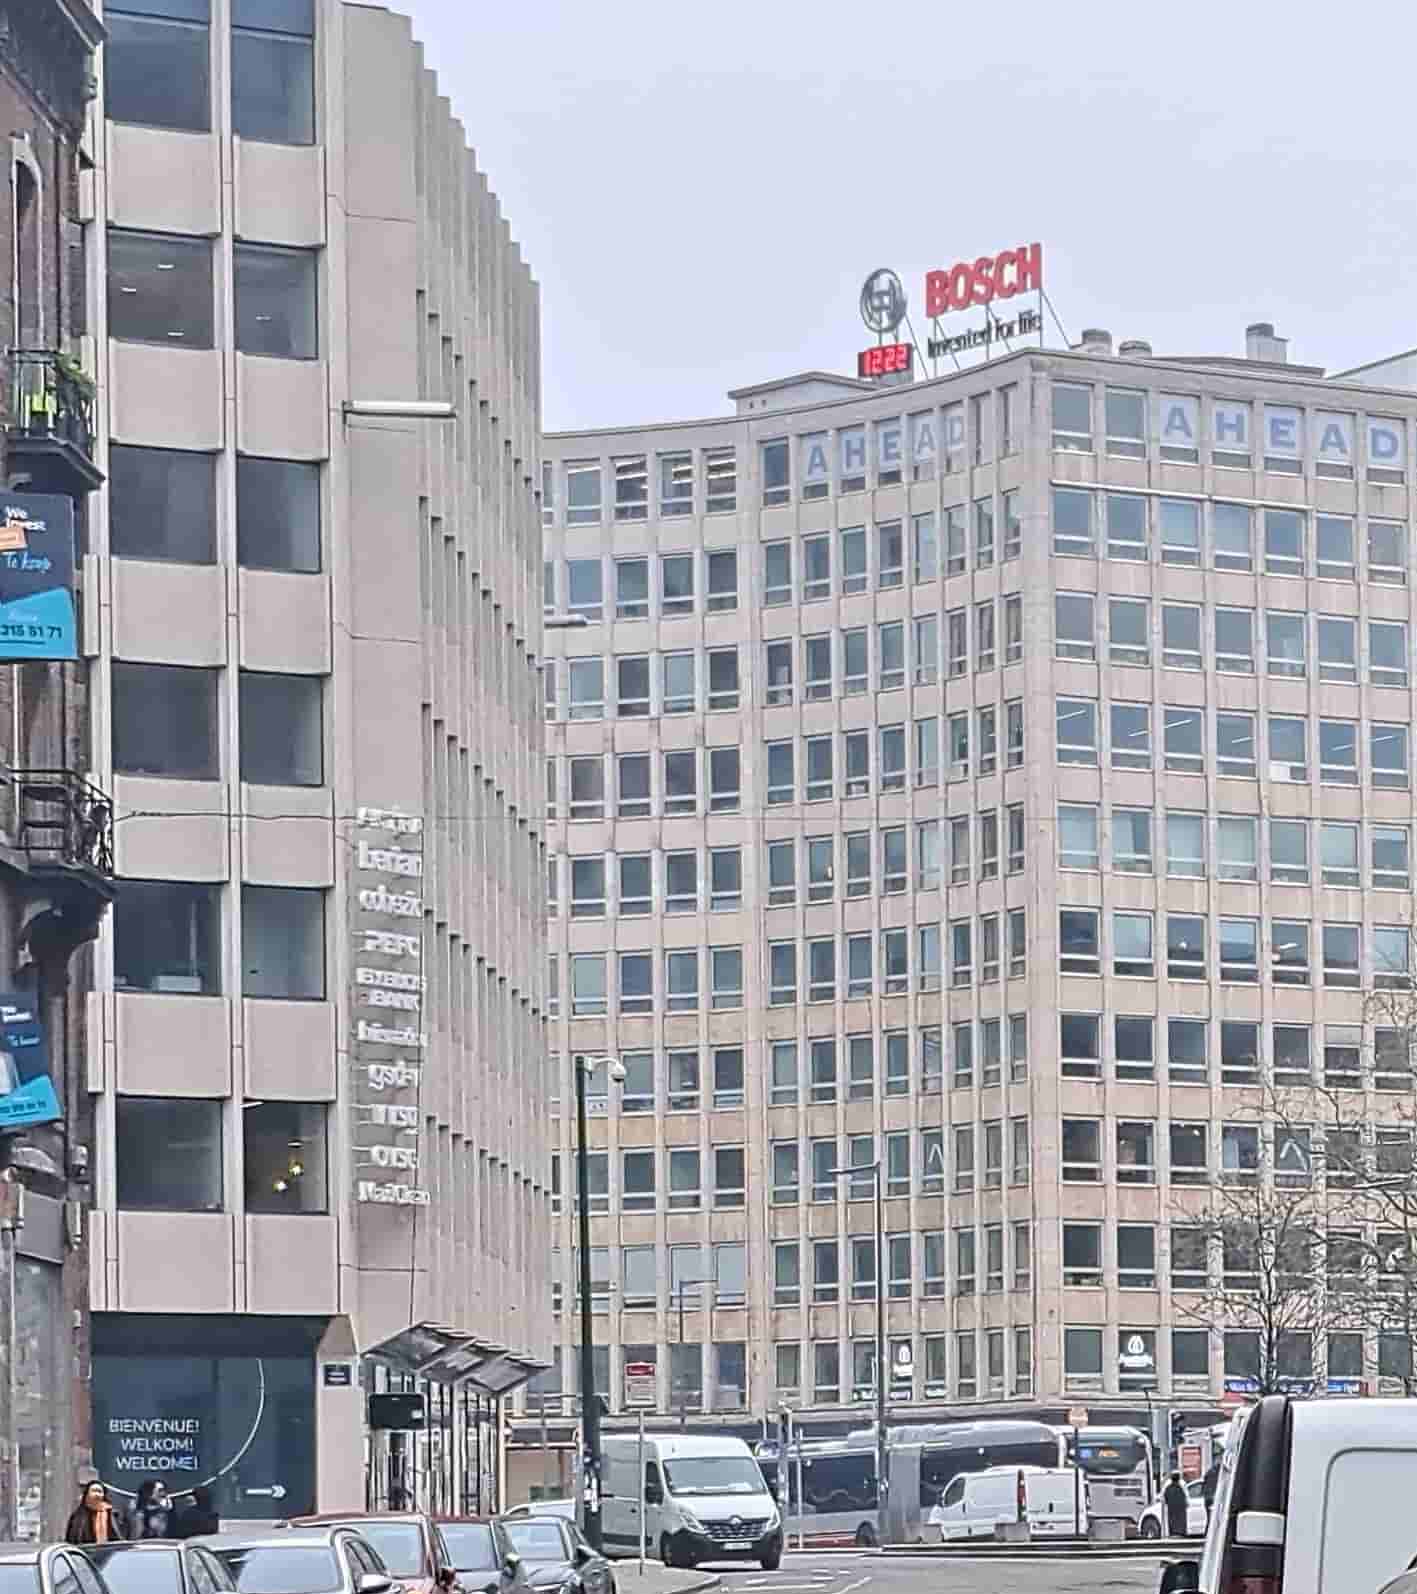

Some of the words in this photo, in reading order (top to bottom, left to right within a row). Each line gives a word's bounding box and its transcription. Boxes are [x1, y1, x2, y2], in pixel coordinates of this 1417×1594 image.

[925, 242, 1042, 318] BOSCH
[994, 317, 1017, 342] for
[1163, 405, 1399, 457] AHEAD
[109, 1419, 199, 1433] BIENVENUE!
[121, 1437, 193, 1452] WELKOM!
[116, 1455, 198, 1470] WELCOME!
